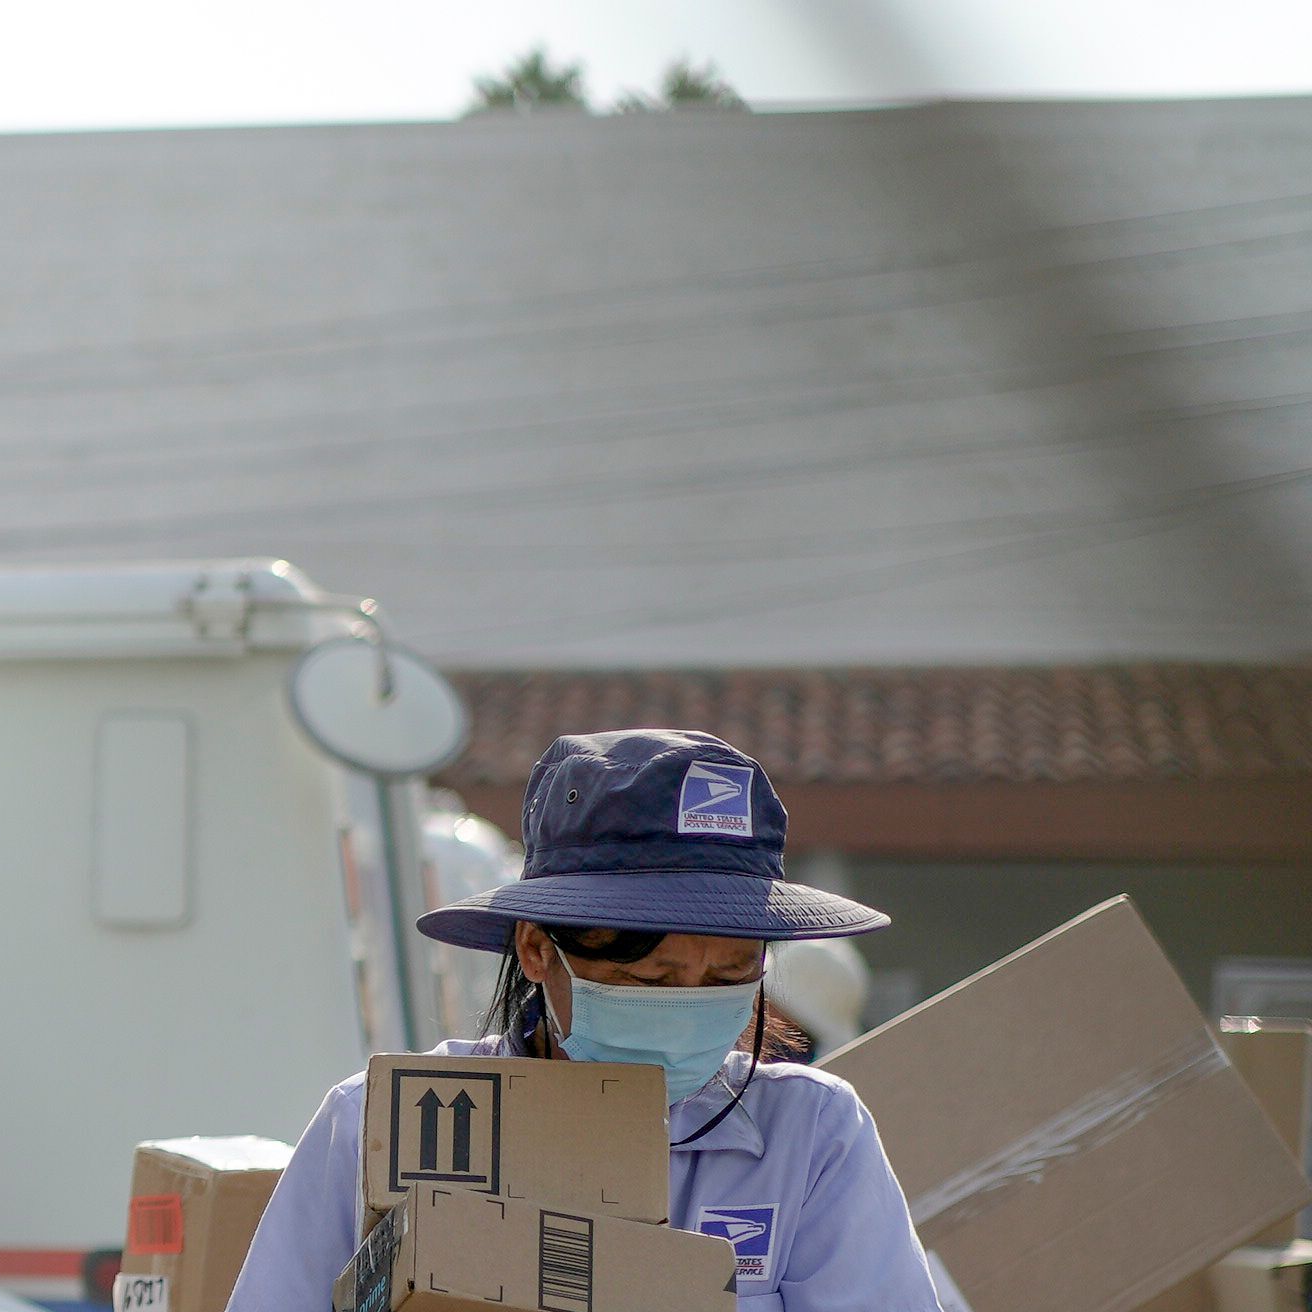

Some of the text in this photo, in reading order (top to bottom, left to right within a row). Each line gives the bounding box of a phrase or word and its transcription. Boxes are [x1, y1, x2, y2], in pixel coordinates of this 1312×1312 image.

[684, 813, 743, 823] UNITED STATES
[684, 821, 714, 829] POSTAL
[736, 1258, 762, 1266] TATES
[736, 1267, 763, 1276] ERVICE
